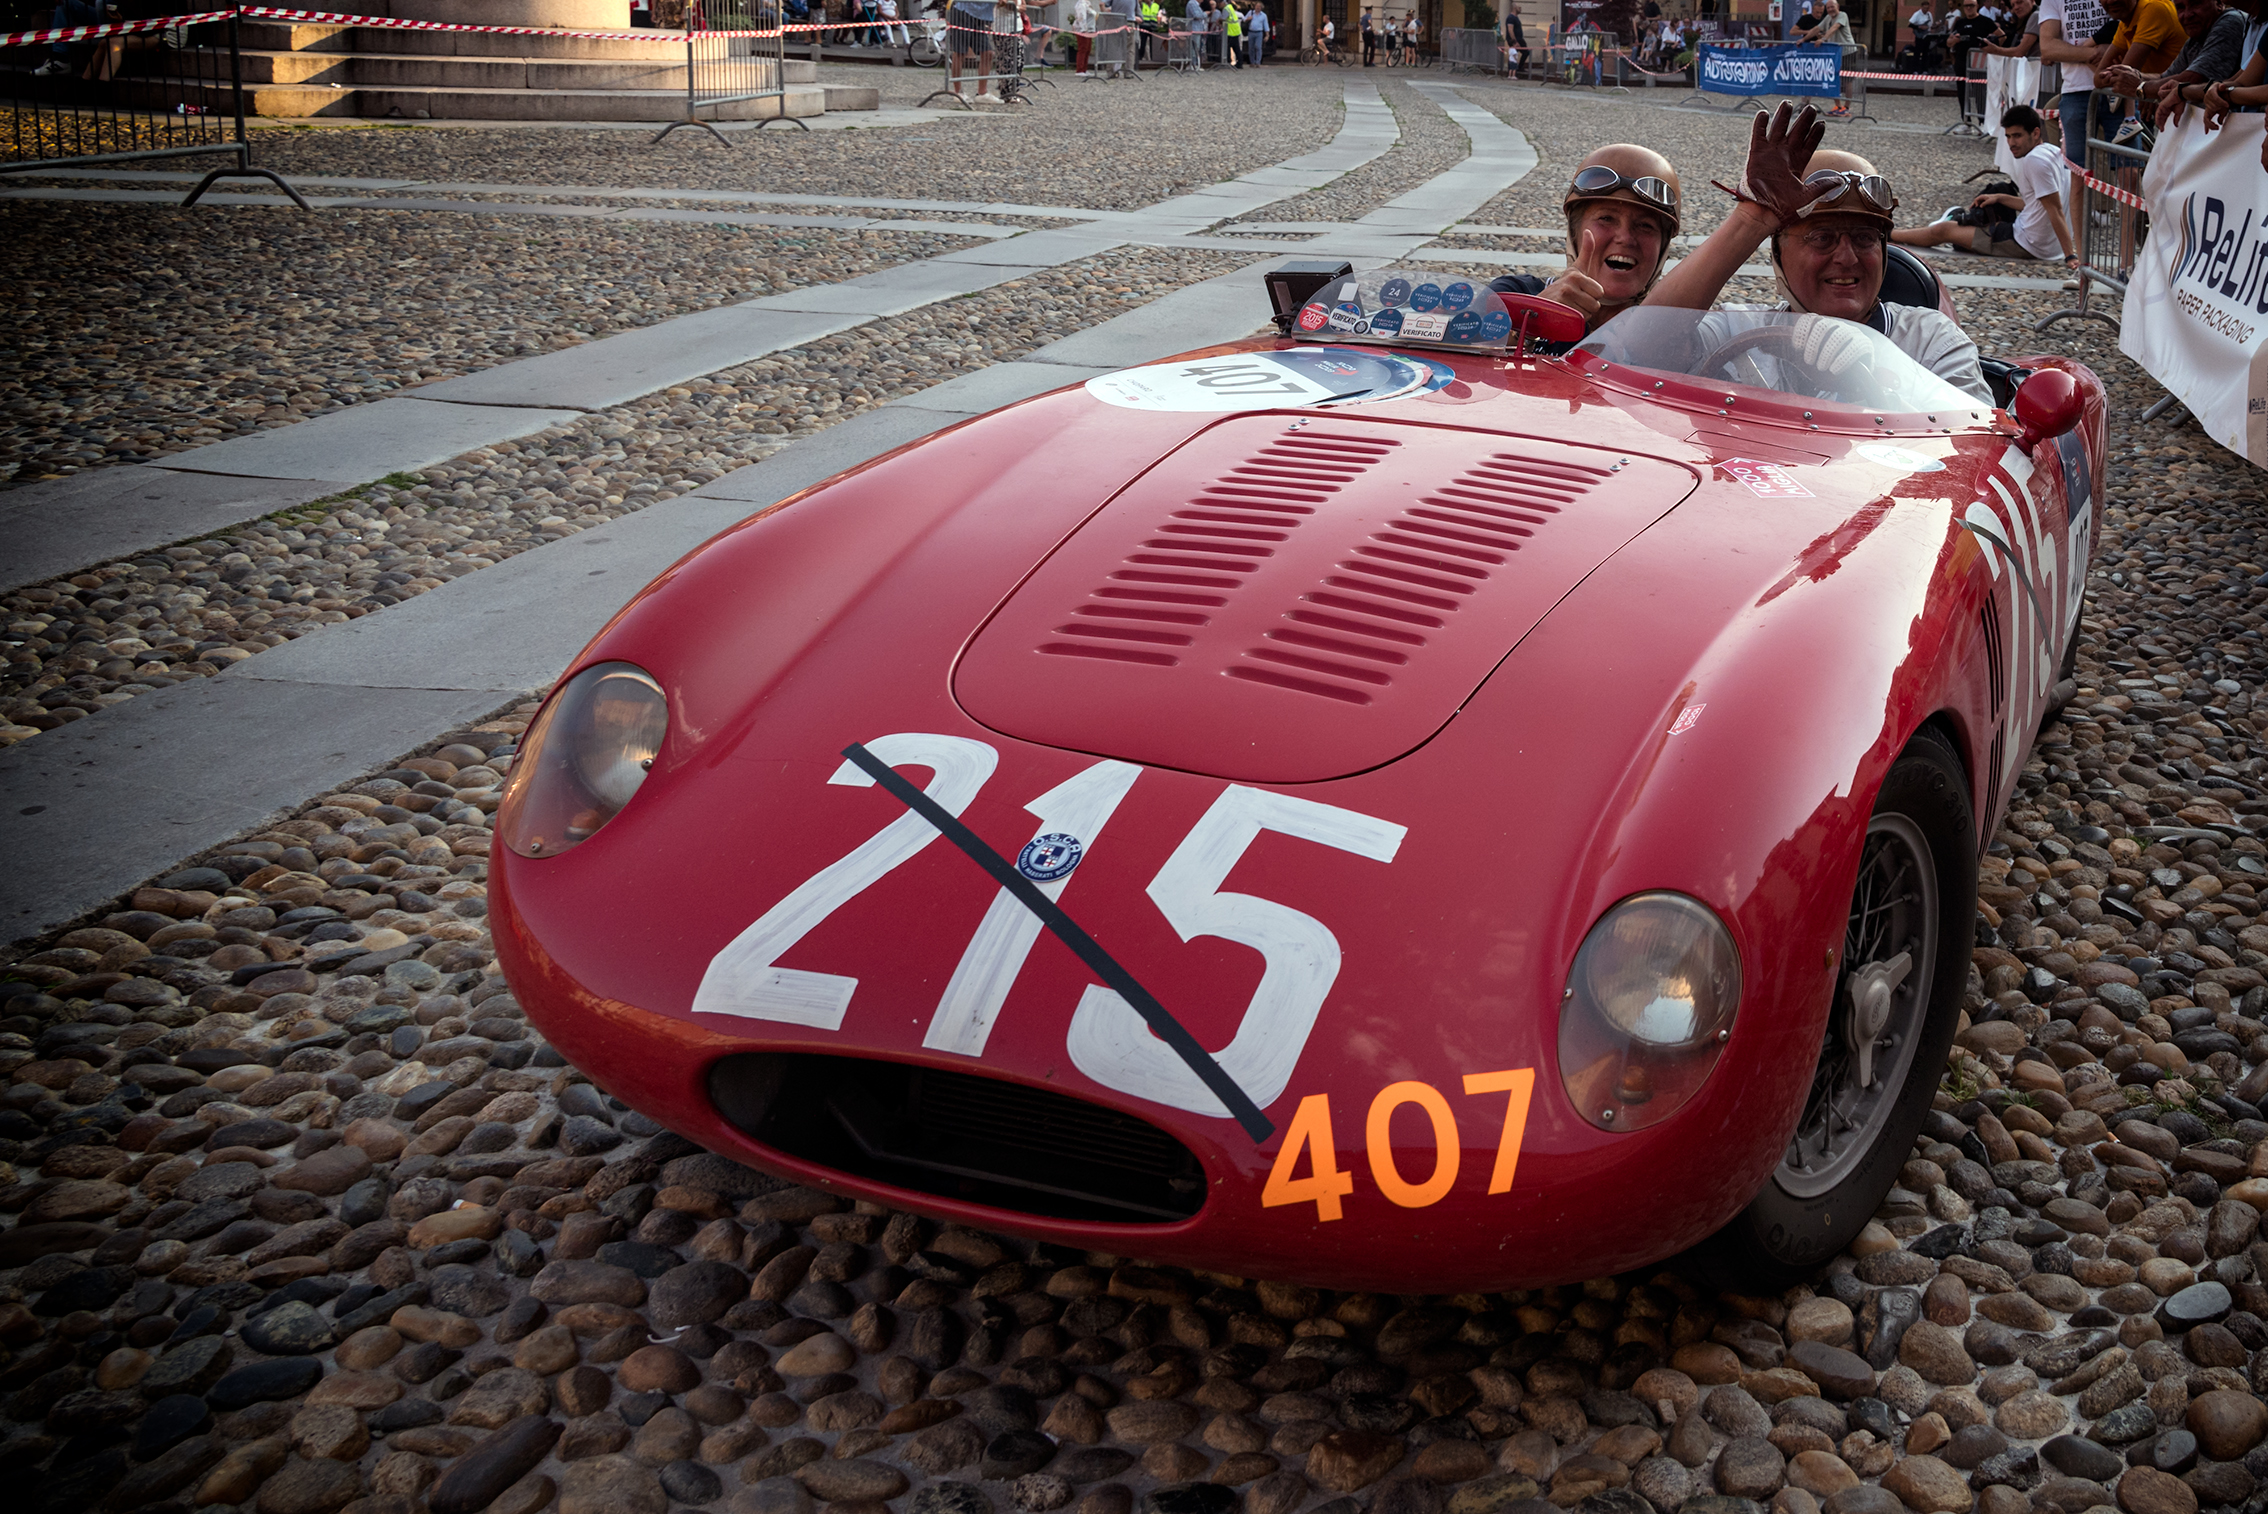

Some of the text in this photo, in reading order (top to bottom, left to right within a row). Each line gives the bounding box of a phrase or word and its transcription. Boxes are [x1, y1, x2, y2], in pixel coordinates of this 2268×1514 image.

[2064, 1, 2095, 13] PODERIA
[2068, 8, 2108, 20] IGUAL BOL
[2066, 22, 2074, 30] DE
[1565, 34, 1588, 51] GALLO
[1704, 57, 1768, 83] AUTOTORINO
[1774, 58, 1835, 82] AUTOTORINO
[1388, 288, 1401, 297] 24
[1303, 311, 1323, 325] 2015
[1331, 312, 1357, 325] VERIFICATO
[2177, 289, 2255, 344] PAPER PACKAGING
[1402, 328, 1441, 338] VERIFICATO
[1180, 364, 1309, 395] 407
[1733, 467, 1776, 493] 1000
[1756, 465, 1806, 495] MIGLIA
[1889, 762, 1968, 832] TOYO 310
[1025, 867, 1053, 878] MASERATI
[1055, 854, 1078, 875] BOLOGNA
[691, 732, 1408, 1119] 215
[1261, 1067, 1536, 1222] 407
